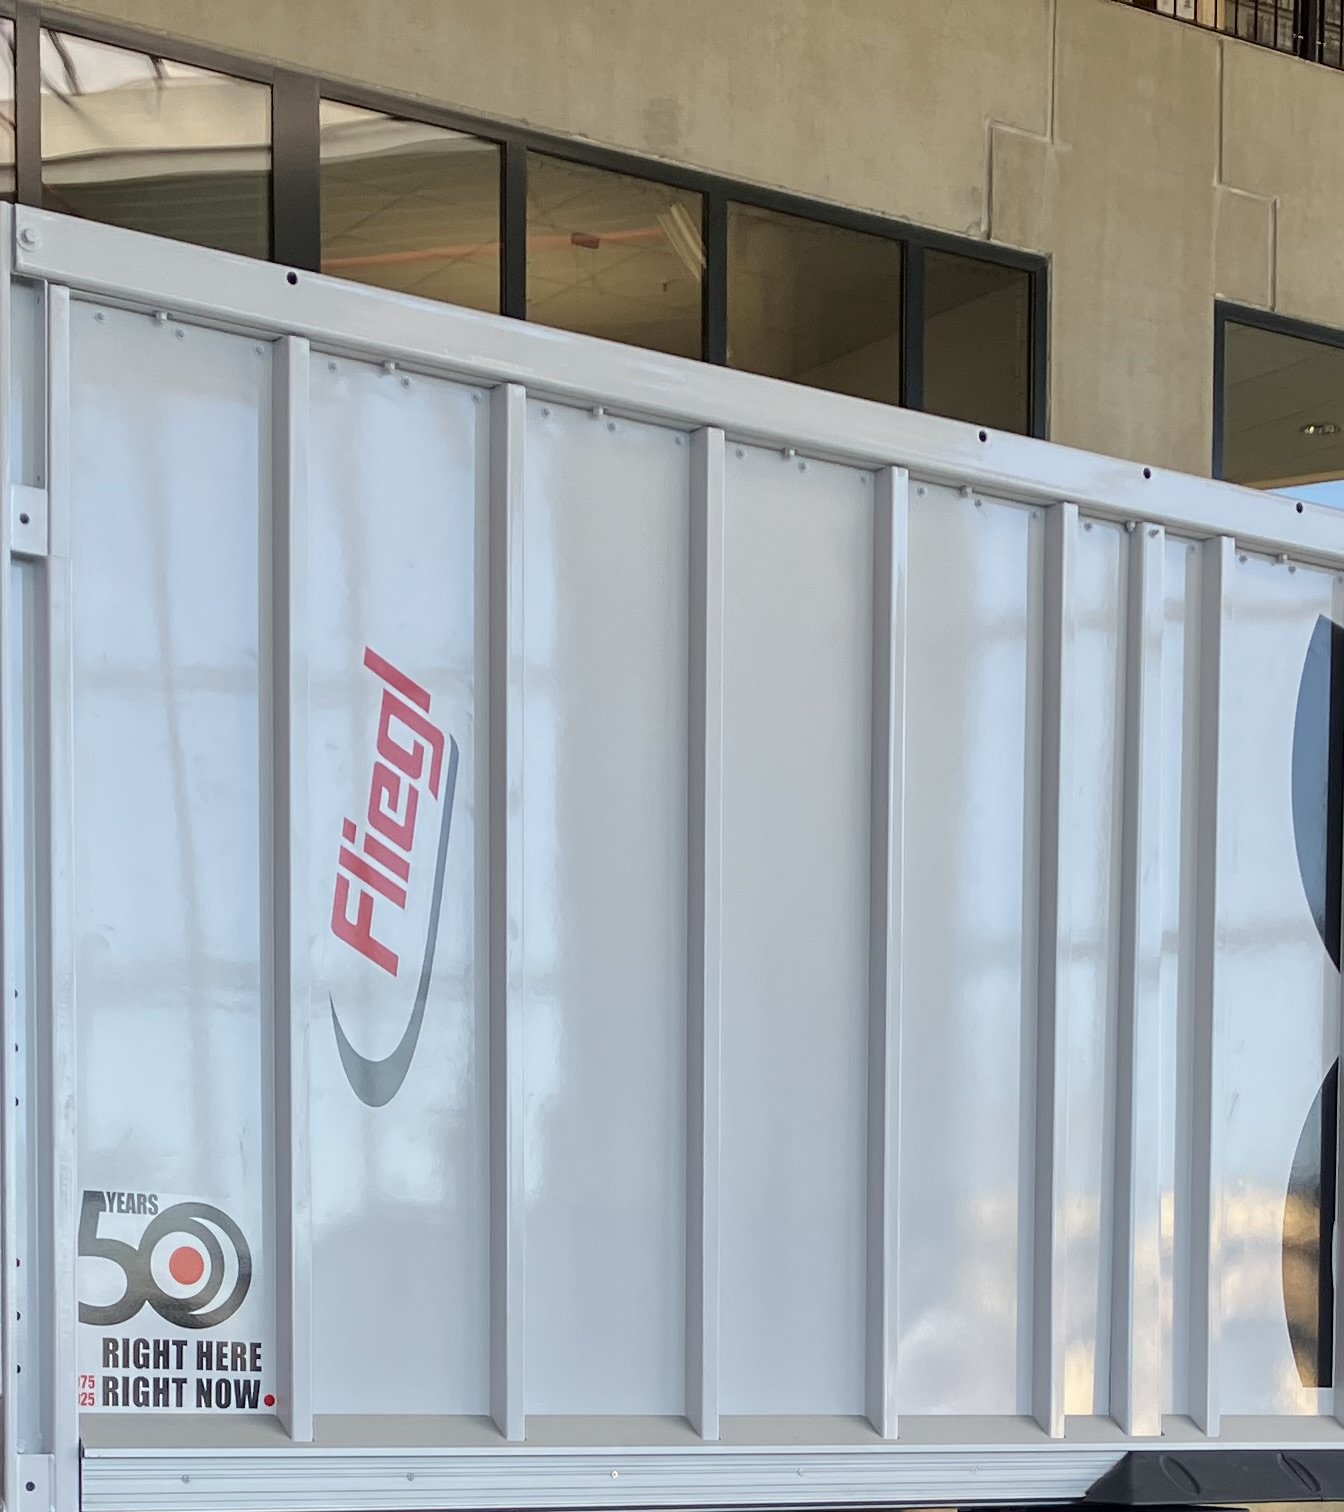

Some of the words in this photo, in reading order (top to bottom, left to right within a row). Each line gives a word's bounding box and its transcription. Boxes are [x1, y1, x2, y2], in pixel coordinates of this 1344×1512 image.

[331, 645, 450, 978] Fliegl
[106, 1191, 159, 1216] YEARS
[78, 1190, 253, 1330] 50
[102, 1337, 188, 1371] RIGHT
[196, 1340, 263, 1372] HERE
[78, 1375, 95, 1389] 75
[102, 1376, 188, 1408] RIGHT
[78, 1392, 95, 1407] 25
